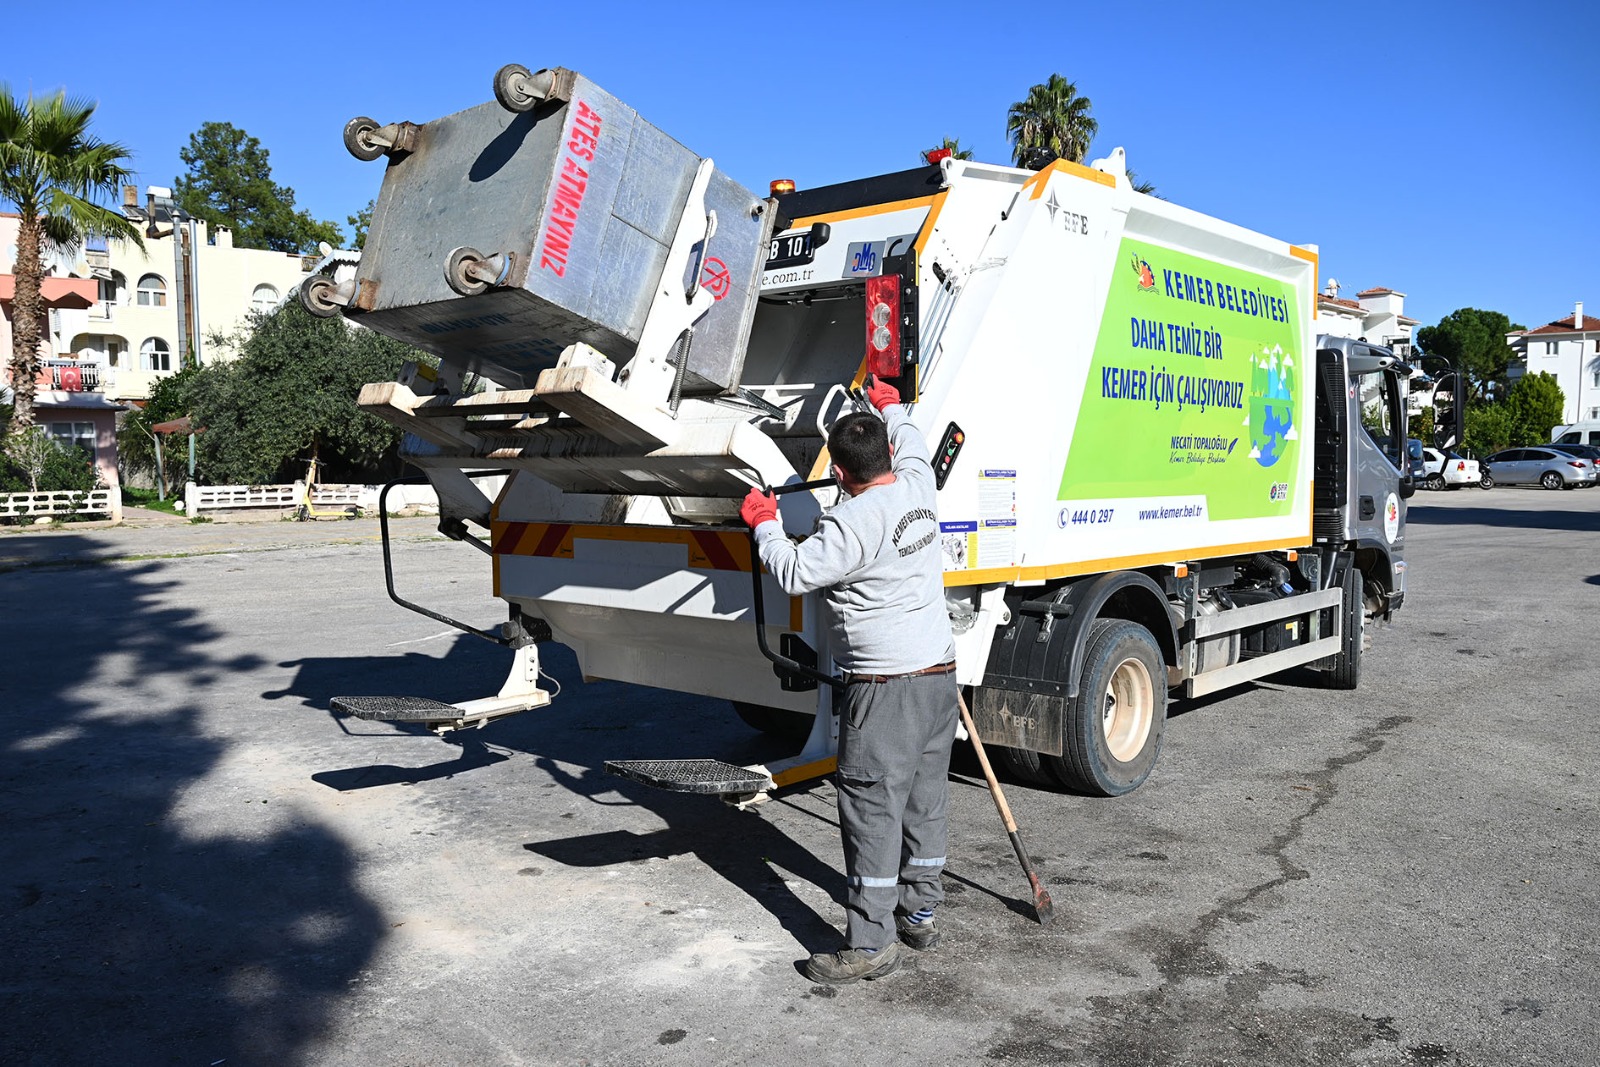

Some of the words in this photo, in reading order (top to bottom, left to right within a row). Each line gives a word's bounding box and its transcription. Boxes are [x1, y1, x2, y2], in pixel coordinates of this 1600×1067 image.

[540, 156, 589, 278] ATMAYINIZ
[767, 240, 779, 260] B
[761, 269, 814, 286] e.com.tr
[1163, 268, 1215, 307] KEMER
[1216, 286, 1289, 324] BELEDİYESİ
[1131, 317, 1166, 352] DAHA
[1167, 321, 1202, 357] TEMİZ
[1204, 325, 1223, 360] BİR
[1102, 366, 1147, 400] KEMER
[1149, 365, 1175, 411] İÇİN
[1177, 374, 1244, 413] ÇALIŞIYORUZ
[1170, 433, 1193, 450] NECATİ
[1193, 434, 1228, 451] TOPALOĞLU
[1071, 510, 1088, 524] 444
[1090, 510, 1096, 524] 0
[1098, 509, 1114, 523] 297
[1139, 504, 1203, 521] www.kemer.bel.tr
